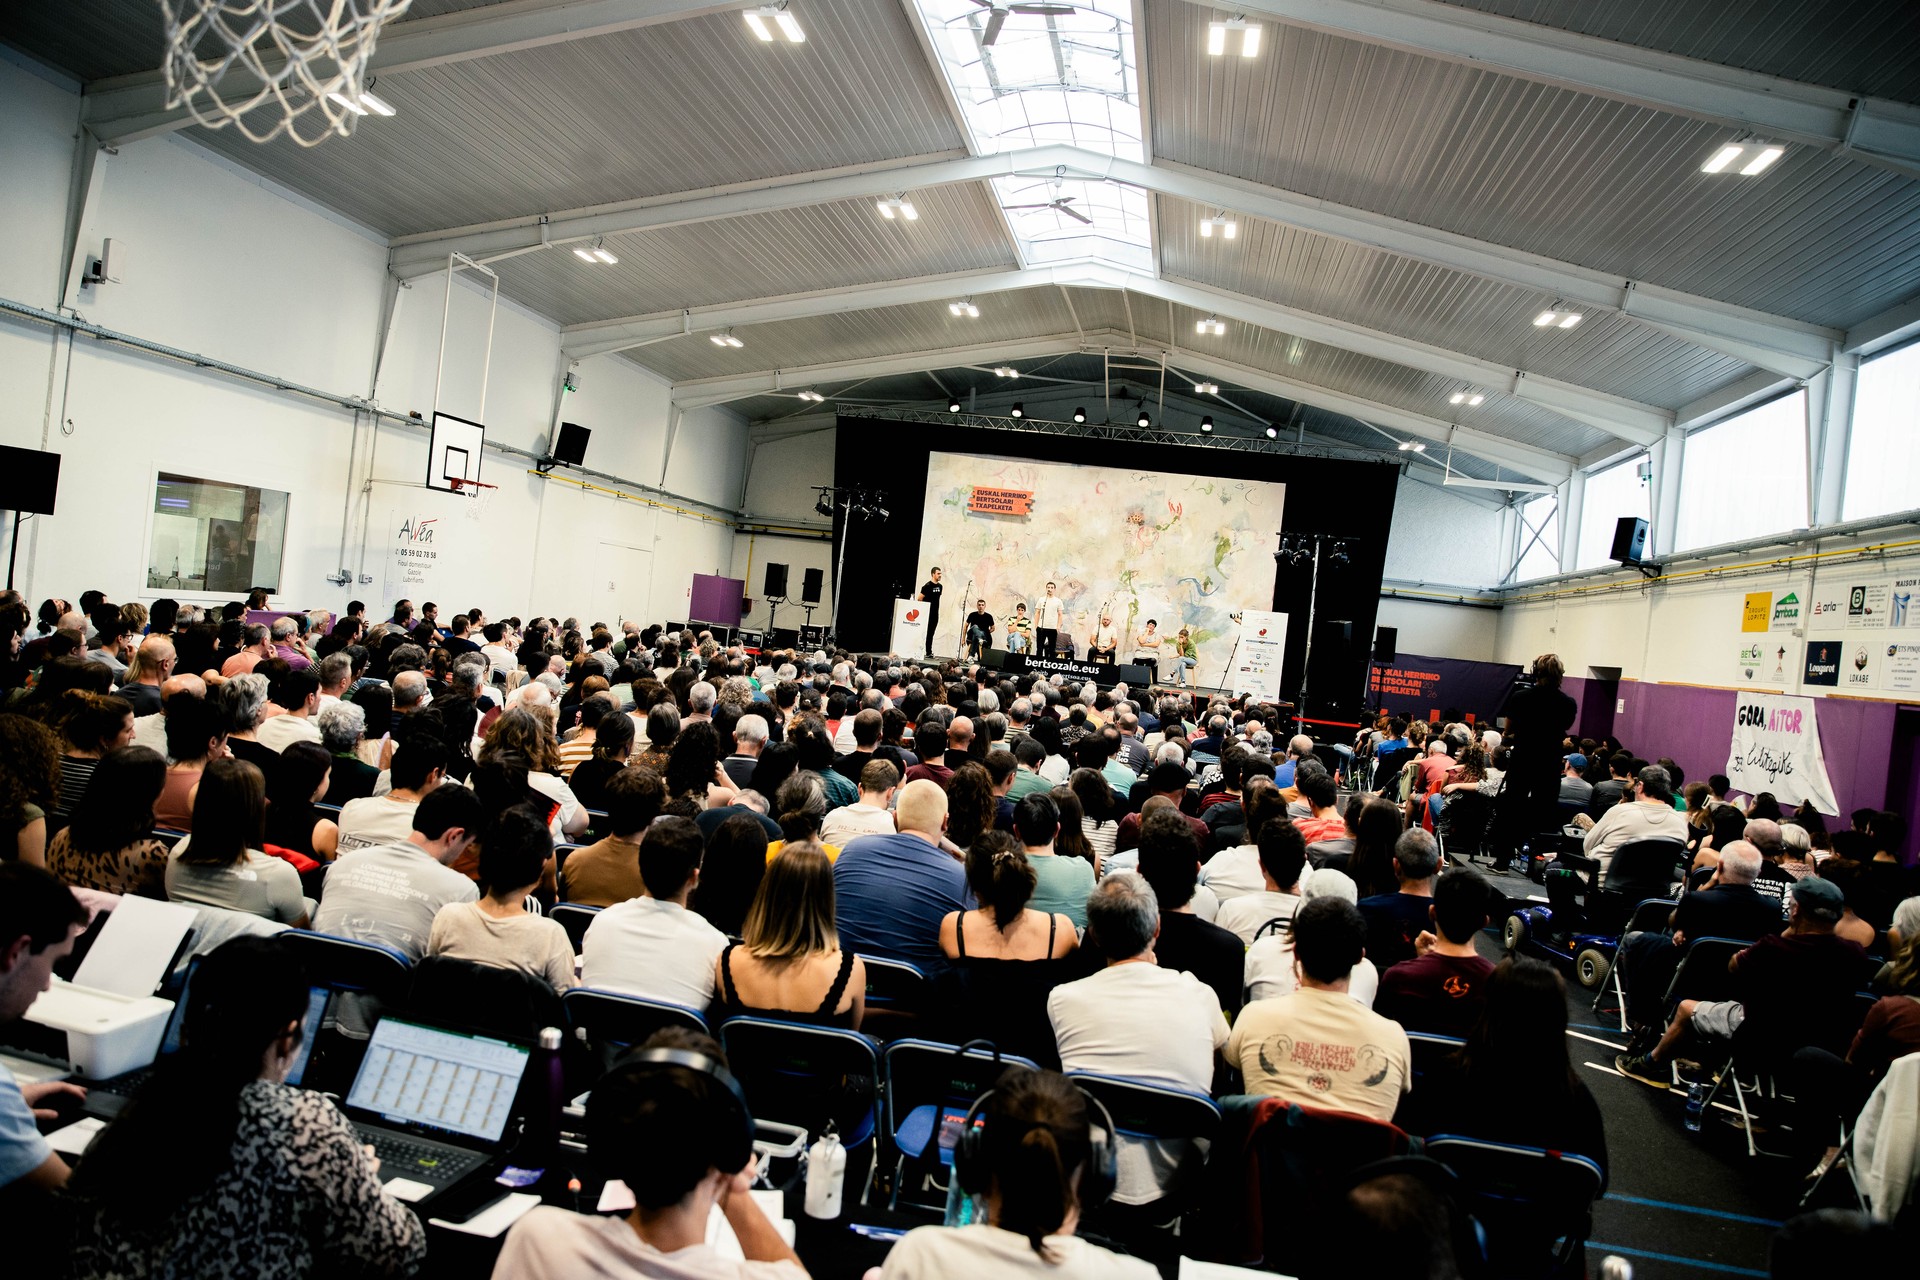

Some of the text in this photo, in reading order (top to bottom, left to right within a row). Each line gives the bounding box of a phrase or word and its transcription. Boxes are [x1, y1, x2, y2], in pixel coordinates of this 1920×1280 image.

[976, 496, 1014, 504] BERTSOLARI
[1000, 492, 1027, 500] HERRIKO
[976, 502, 1012, 511] TXAPELKETA
[1025, 656, 1100, 674] bertsozale.eus
[1404, 671, 1440, 681] HERRIKO
[1422, 681, 1434, 689] 20
